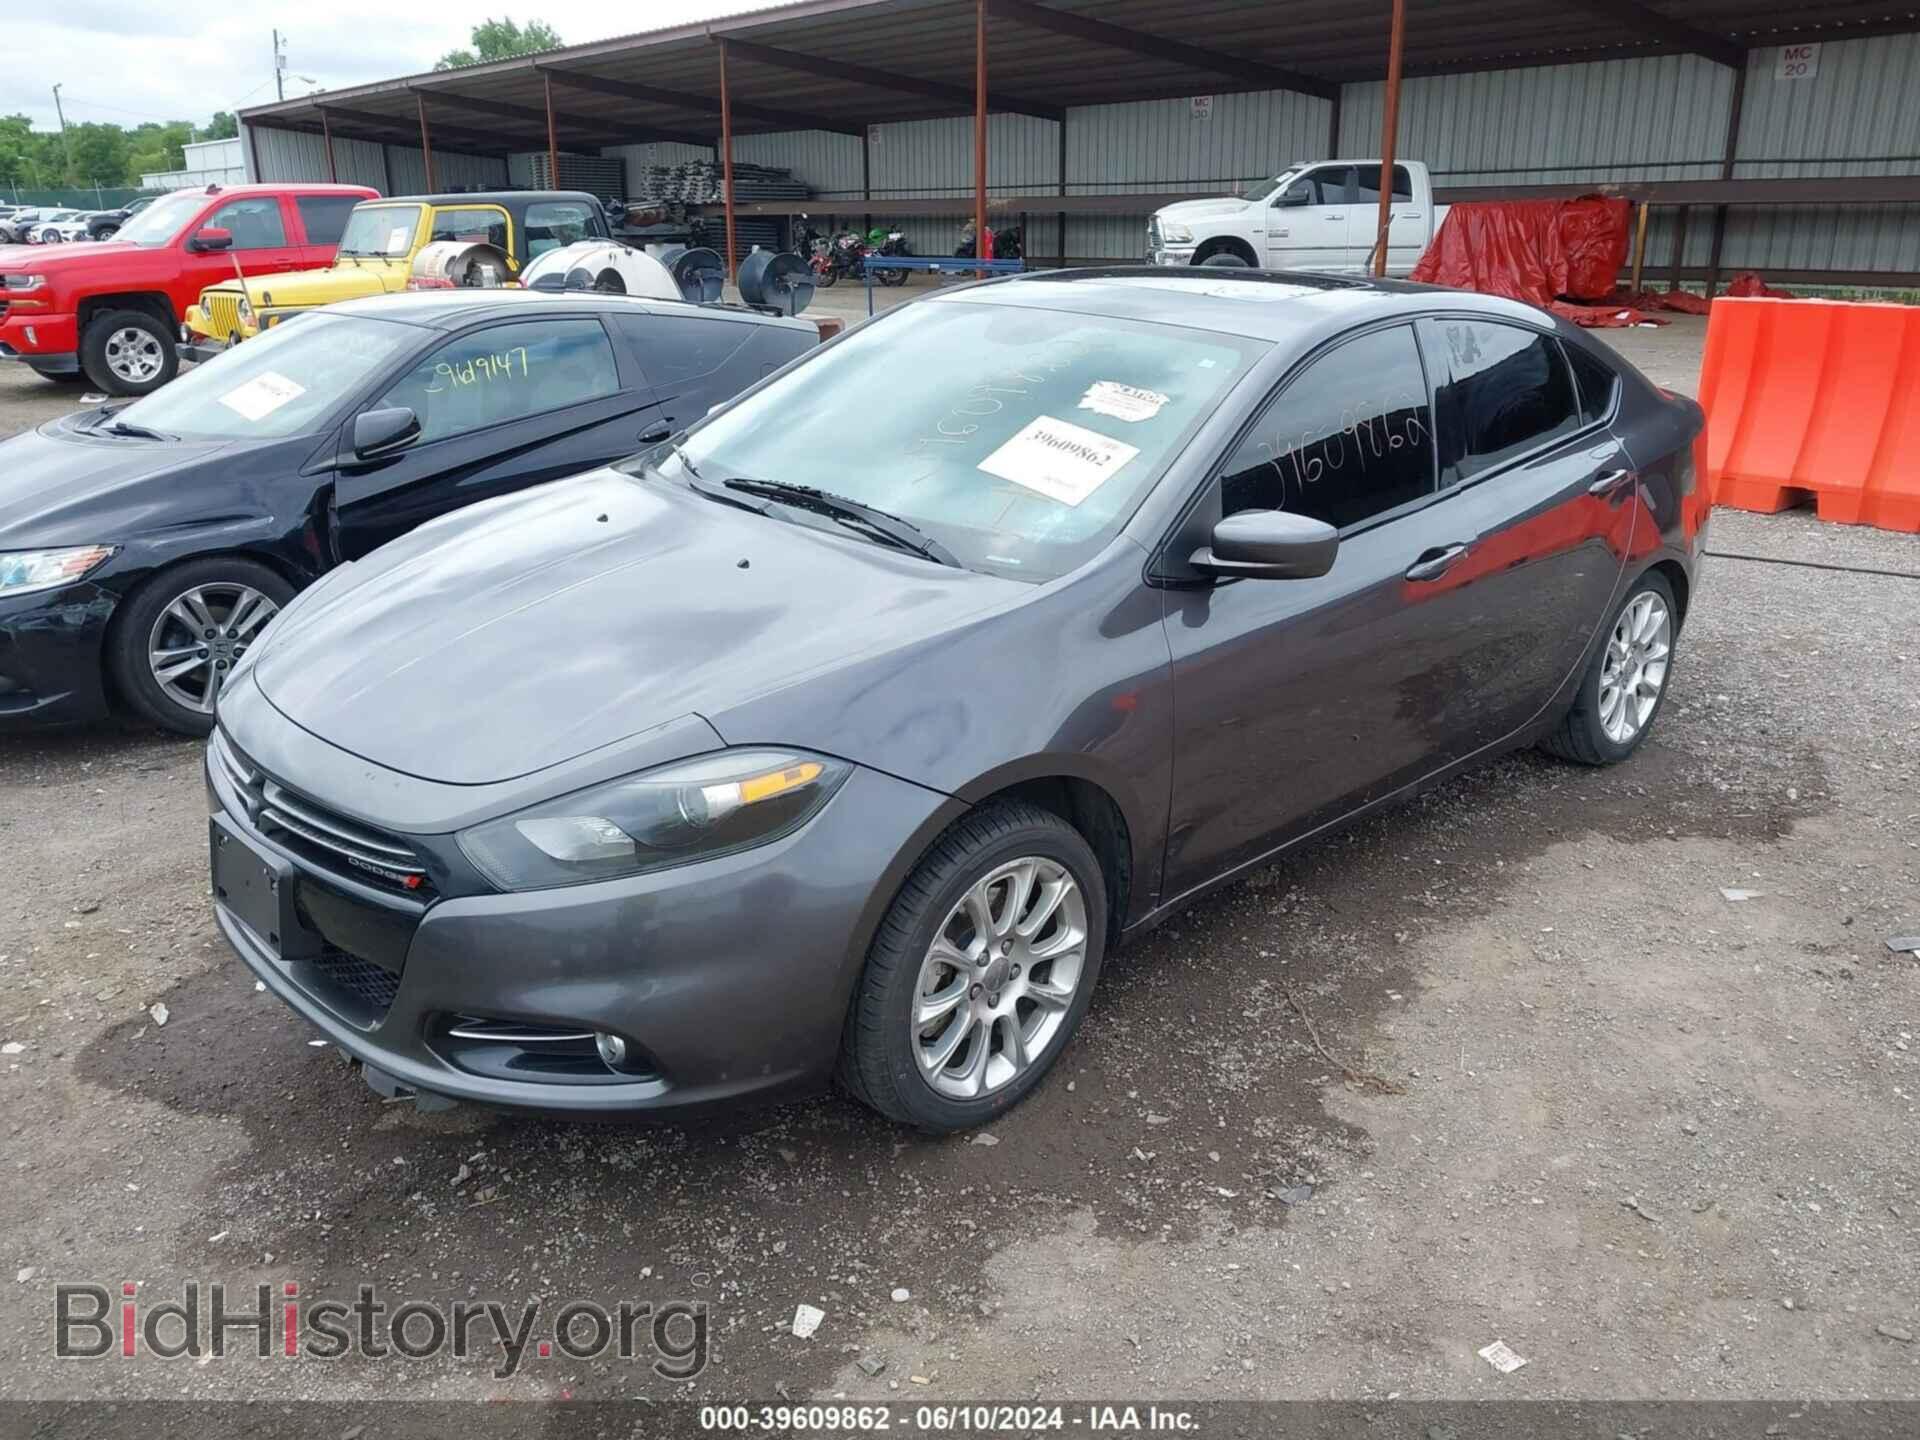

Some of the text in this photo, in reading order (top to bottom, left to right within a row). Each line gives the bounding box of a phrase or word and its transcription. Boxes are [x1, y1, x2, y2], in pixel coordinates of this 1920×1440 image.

[1783, 46, 1813, 61] MC
[1783, 62, 1808, 76] 20
[1026, 429, 1112, 467] 39609862
